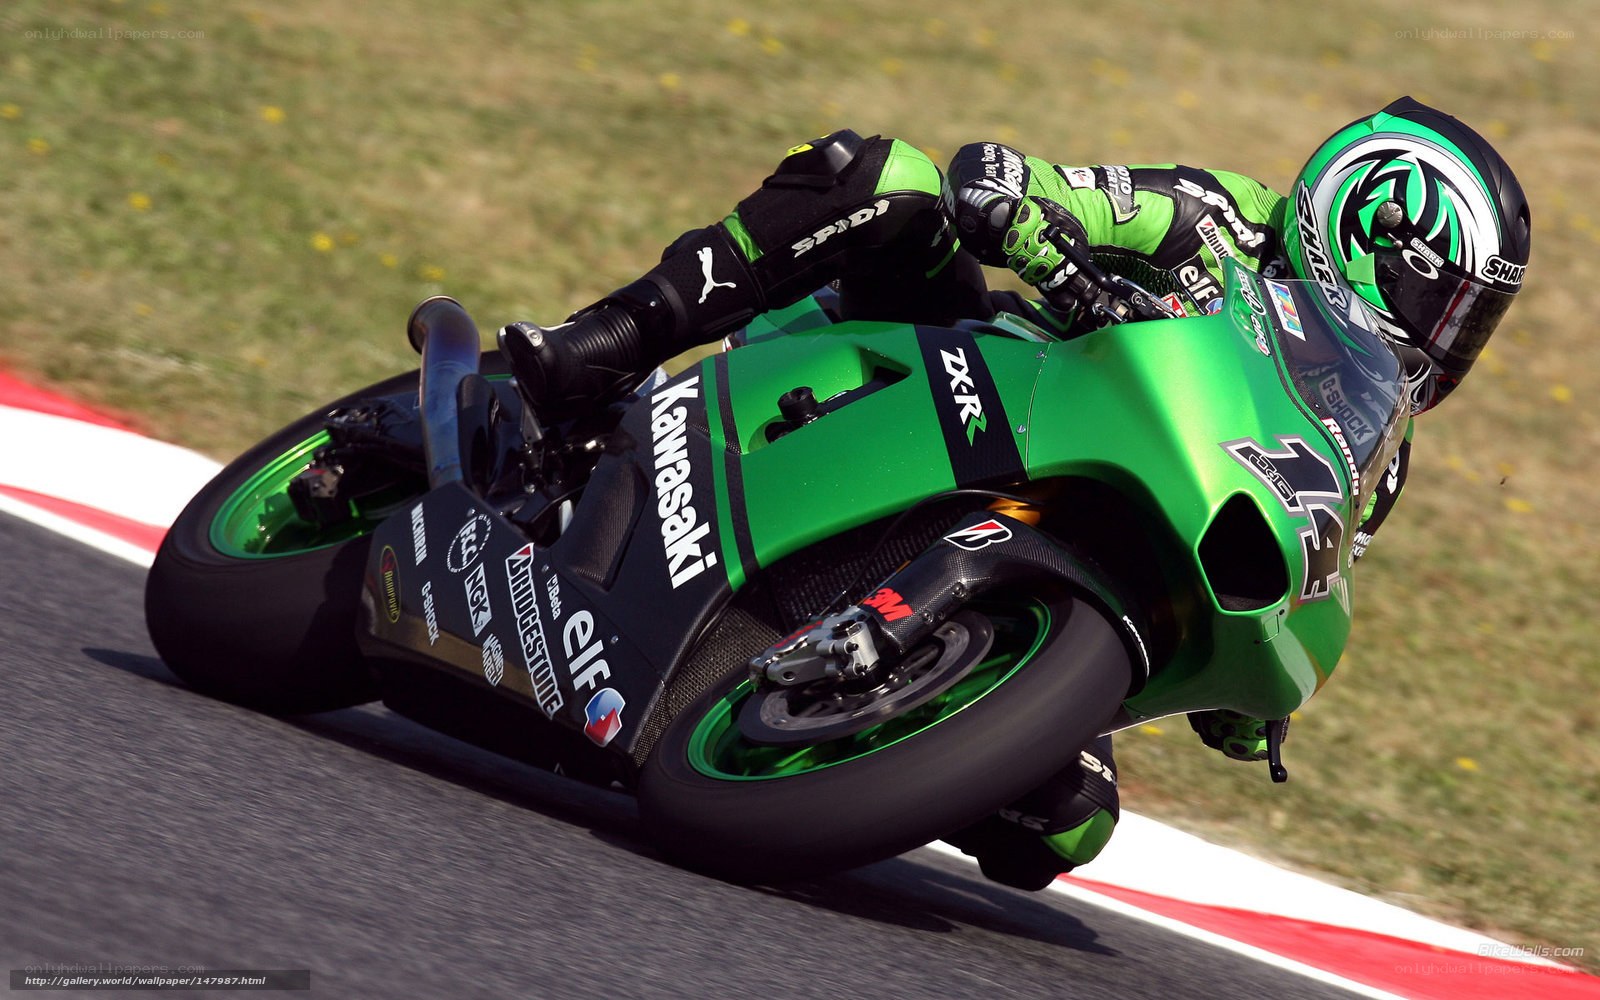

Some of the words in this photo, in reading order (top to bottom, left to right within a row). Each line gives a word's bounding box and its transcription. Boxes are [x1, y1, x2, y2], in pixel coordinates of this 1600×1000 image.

[791, 200, 890, 258] SPIDI
[1296, 180, 1348, 310] SHARK
[1411, 238, 1444, 267] SHARK
[1179, 265, 1219, 301] elf
[940, 347, 986, 436] ZX-R
[1322, 377, 1372, 441] G-SHOCK
[651, 376, 718, 590] Kawasaki
[1320, 417, 1360, 496] Randy
[421, 581, 440, 646] G-SHOCK
[466, 565, 489, 627] NGK
[549, 585, 562, 620] Beta
[863, 588, 912, 621] 3M
[507, 544, 563, 718] BRIDGESTONE
[563, 610, 611, 691] elf
